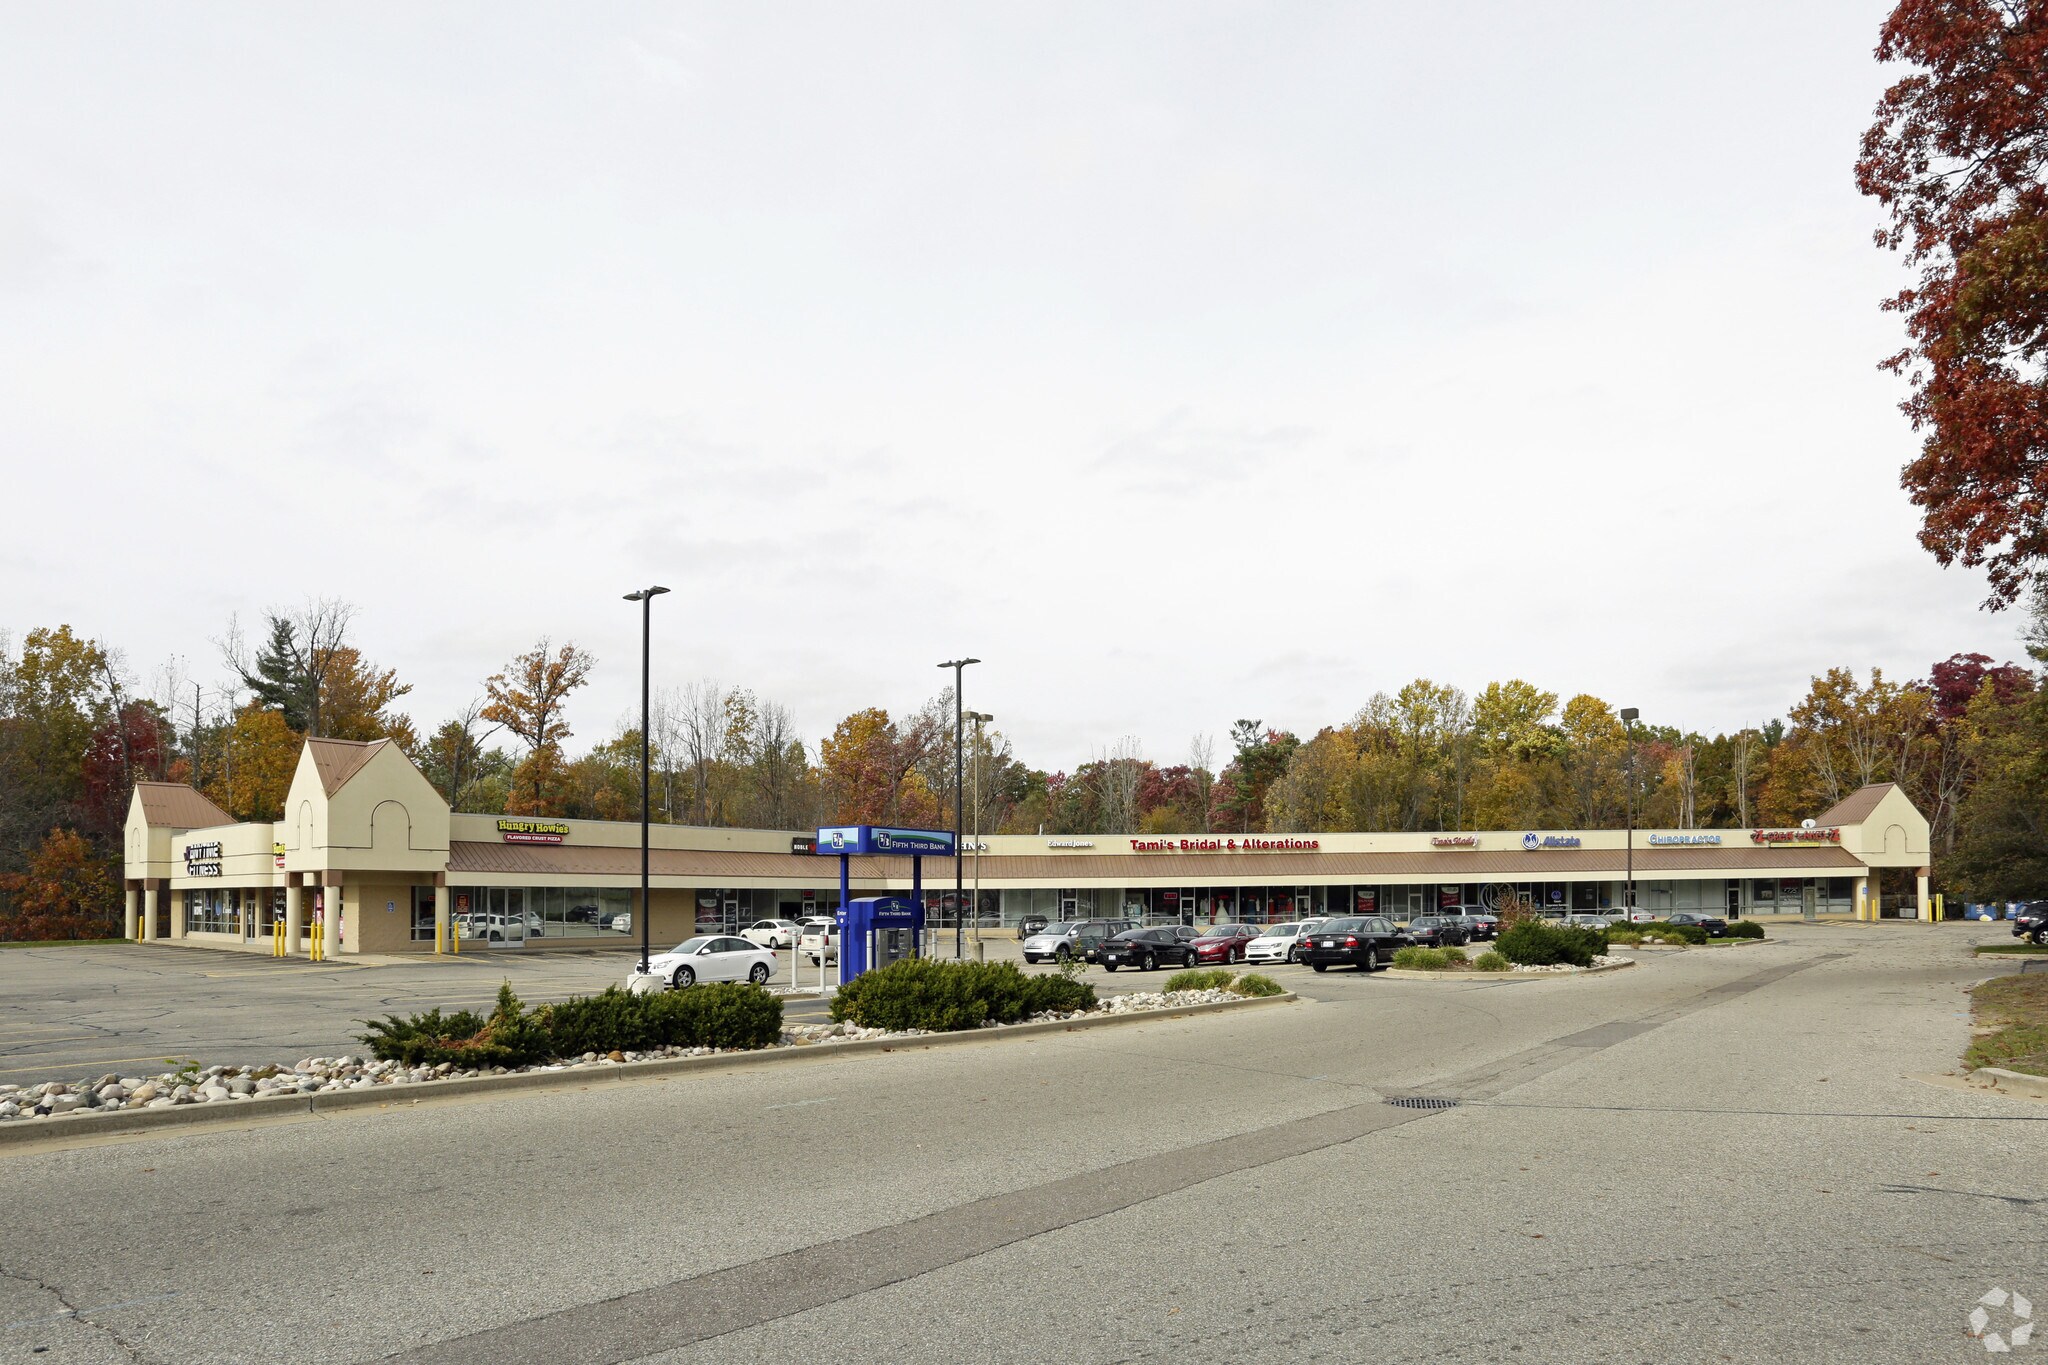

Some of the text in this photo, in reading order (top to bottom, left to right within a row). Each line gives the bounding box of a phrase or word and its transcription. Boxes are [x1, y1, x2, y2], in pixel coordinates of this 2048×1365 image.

[498, 820, 569, 834] Hungry Howie's
[892, 841, 946, 851] FIFTH THIRD BANK
[1130, 838, 1319, 850] Tami's Bridal & Alterations
[1543, 836, 1581, 847] Allstate
